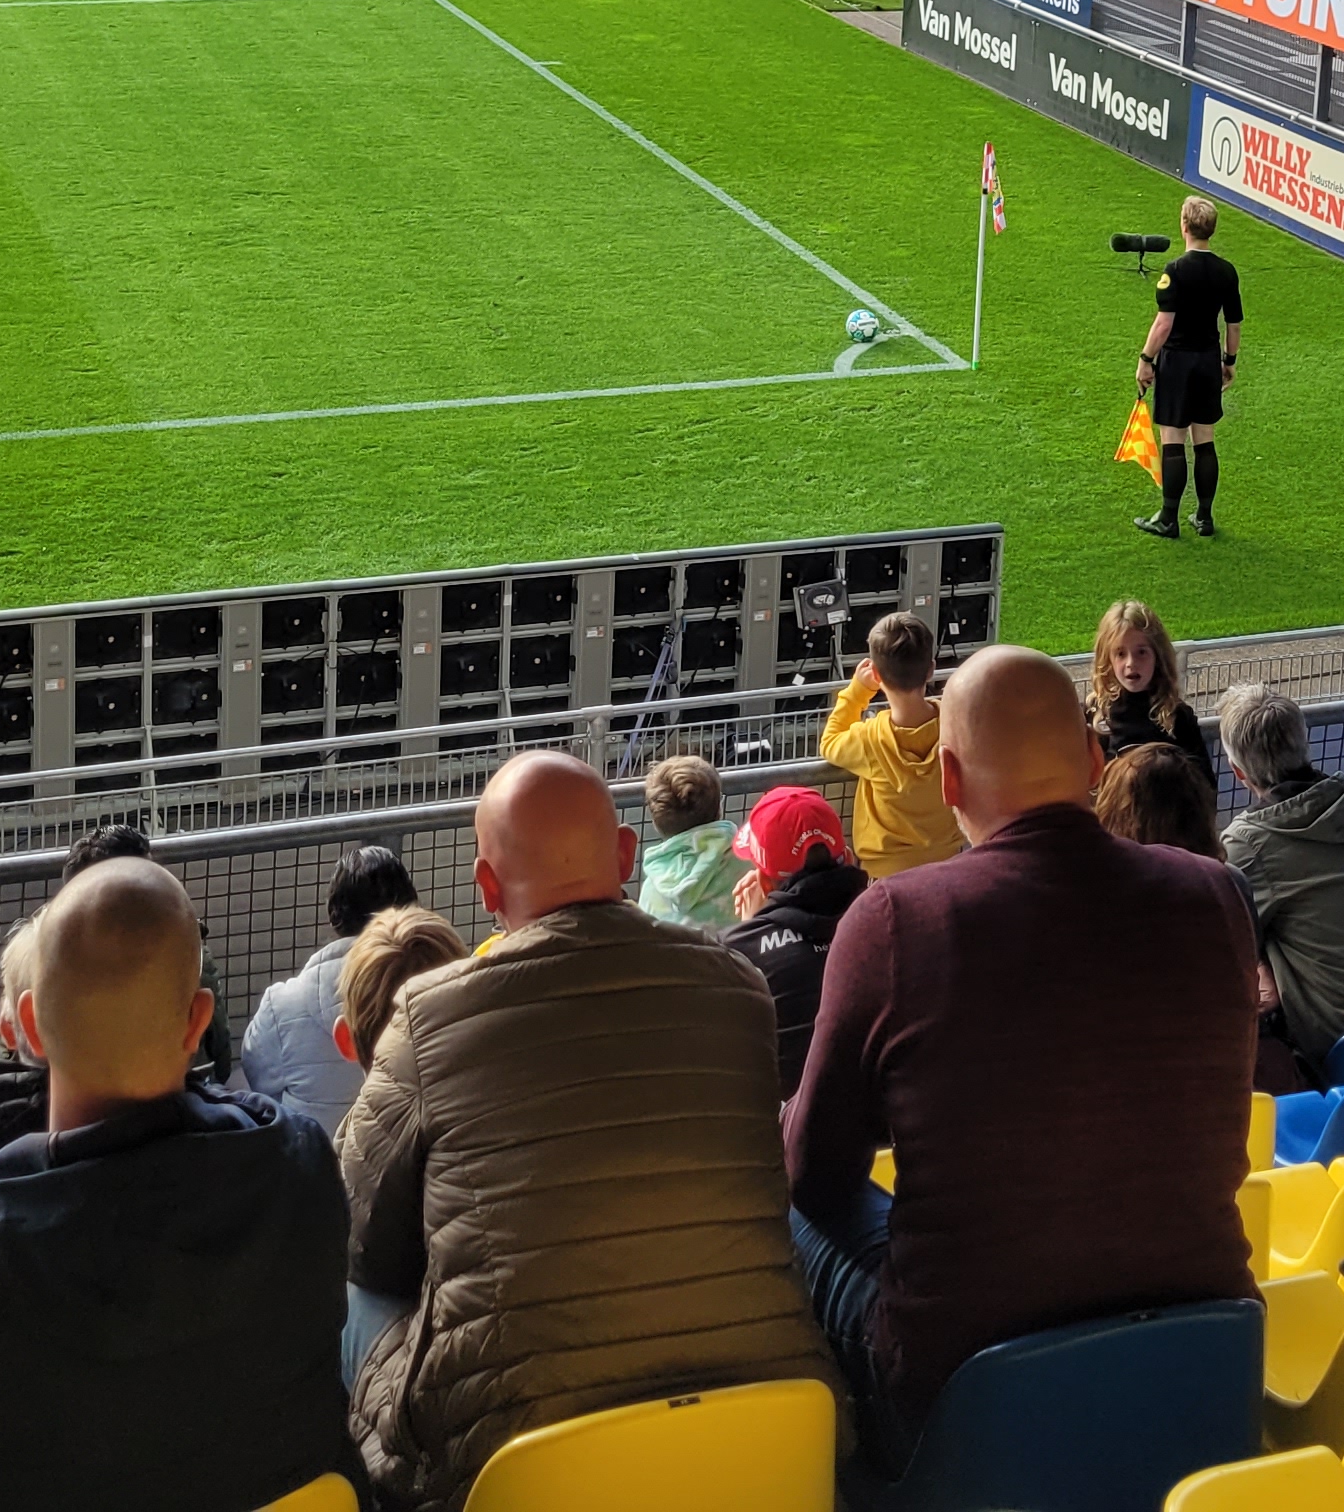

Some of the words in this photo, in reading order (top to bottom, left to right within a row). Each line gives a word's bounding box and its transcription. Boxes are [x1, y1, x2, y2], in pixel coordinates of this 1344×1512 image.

[953, 11, 1017, 72] Mossel
[1048, 52, 1087, 105] Van
[1091, 71, 1171, 141] Mossel
[1241, 122, 1312, 179] WILLY
